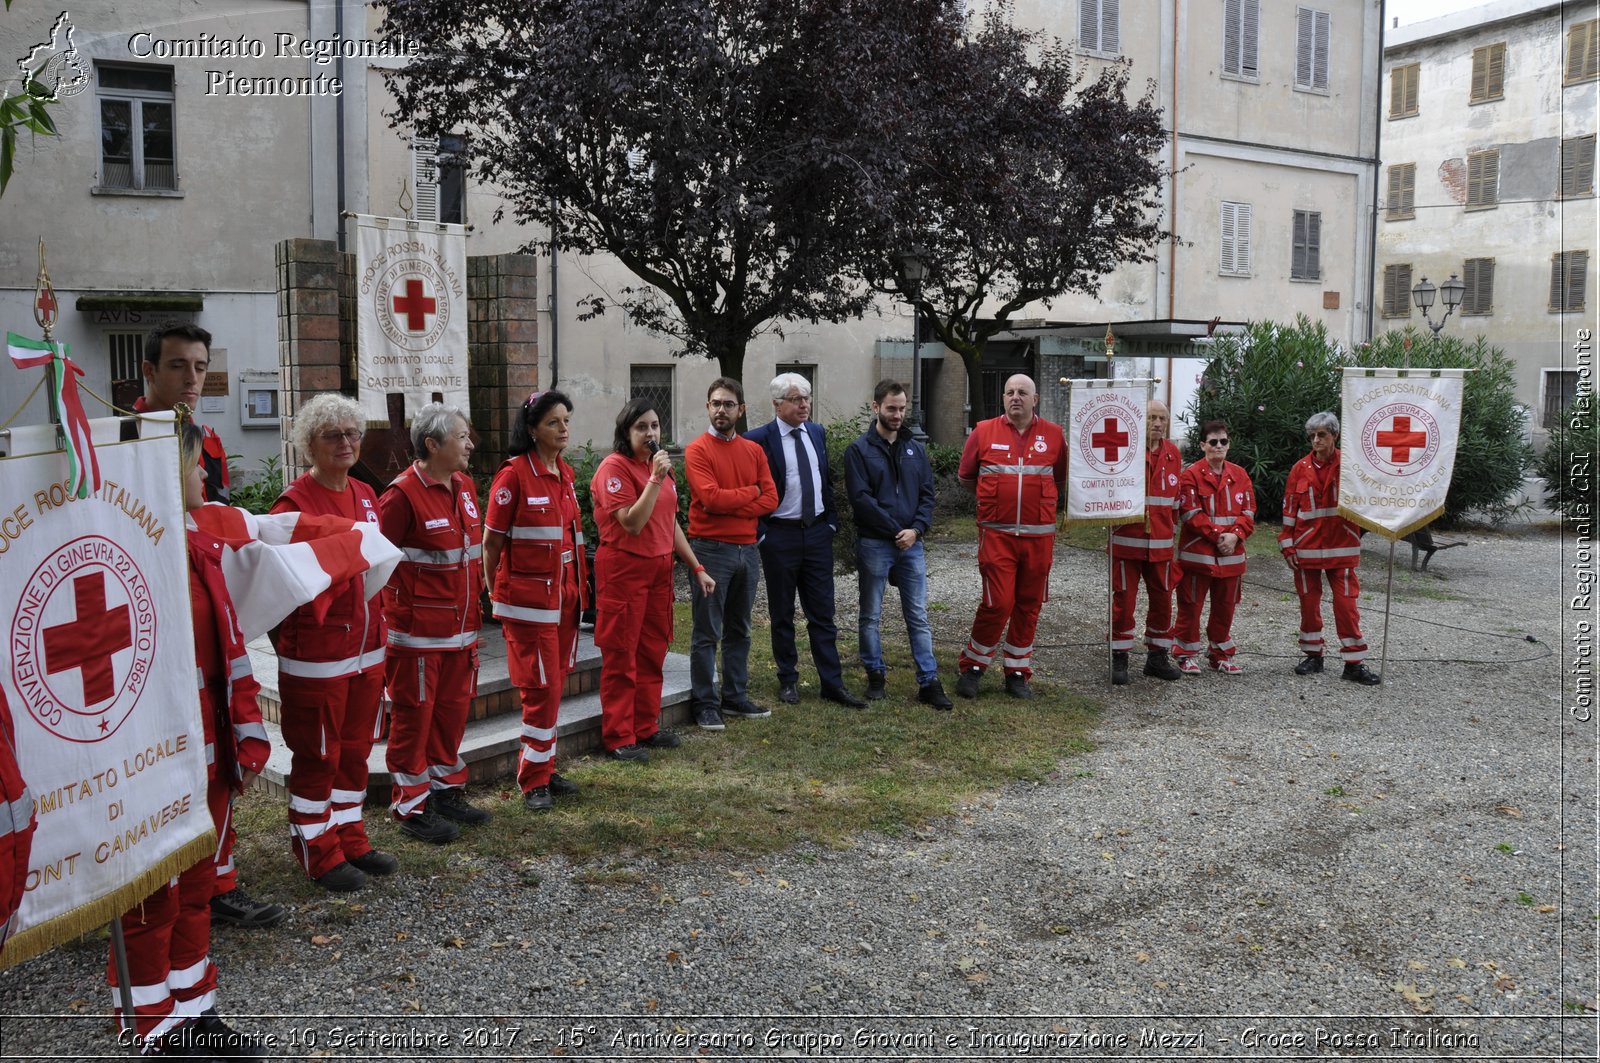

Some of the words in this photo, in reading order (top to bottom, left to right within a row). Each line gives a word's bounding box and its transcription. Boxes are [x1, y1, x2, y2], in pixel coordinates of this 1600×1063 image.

[361, 252, 387, 295] CROCE
[387, 241, 426, 259] ROSSA
[428, 247, 463, 300] ITALIANA
[389, 268, 398, 280] DI
[98, 310, 142, 323] AVIS
[377, 281, 408, 346] CONVENZIONE
[373, 356, 421, 365] COMITATO
[424, 356, 454, 365] LOCALE
[415, 366, 423, 375] DI
[367, 376, 462, 388] CASTELLAMONTE
[1075, 399, 1095, 423] CROCE
[1096, 393, 1119, 404] ROSSA
[1121, 396, 1143, 421] ITALIANA
[1352, 388, 1382, 412] CROCE
[1383, 383, 1415, 394] ROSSA
[1416, 387, 1451, 412] ITALIANA
[1378, 410, 1387, 419] DI
[1386, 405, 1420, 416] GINEVRA
[1420, 413, 1431, 423] 22
[1081, 418, 1097, 466] CONVENZIONE
[1099, 407, 1124, 417] GINEVRA
[1123, 414, 1131, 422] 22
[1363, 415, 1381, 466] CONVENZIONE
[1428, 419, 1438, 451] AGOSTO
[1419, 451, 1433, 467] 1864
[1082, 480, 1114, 489] COMITATO
[1352, 463, 1398, 496] COMITATO
[1400, 473, 1440, 496] LOCALE
[1437, 466, 1447, 477] DI
[1108, 489, 1115, 498] DI
[1344, 496, 1367, 506] SAN
[1368, 496, 1417, 508] GIORGIO
[0, 503, 34, 554] OCE
[103, 480, 166, 546] ITALIANA
[1084, 500, 1133, 512] STRAMBINO
[57, 542, 114, 573] GINEVRA
[117, 555, 131, 578] 22
[38, 565, 58, 586] DI
[127, 574, 152, 651] AGOSTO
[15, 585, 62, 727] CONVENZIONE
[127, 656, 148, 695] 1864
[123, 734, 188, 778] LOCALE
[108, 799, 124, 821] DI
[23, 852, 81, 892] ONT
[95, 793, 192, 864] CANAVESE
